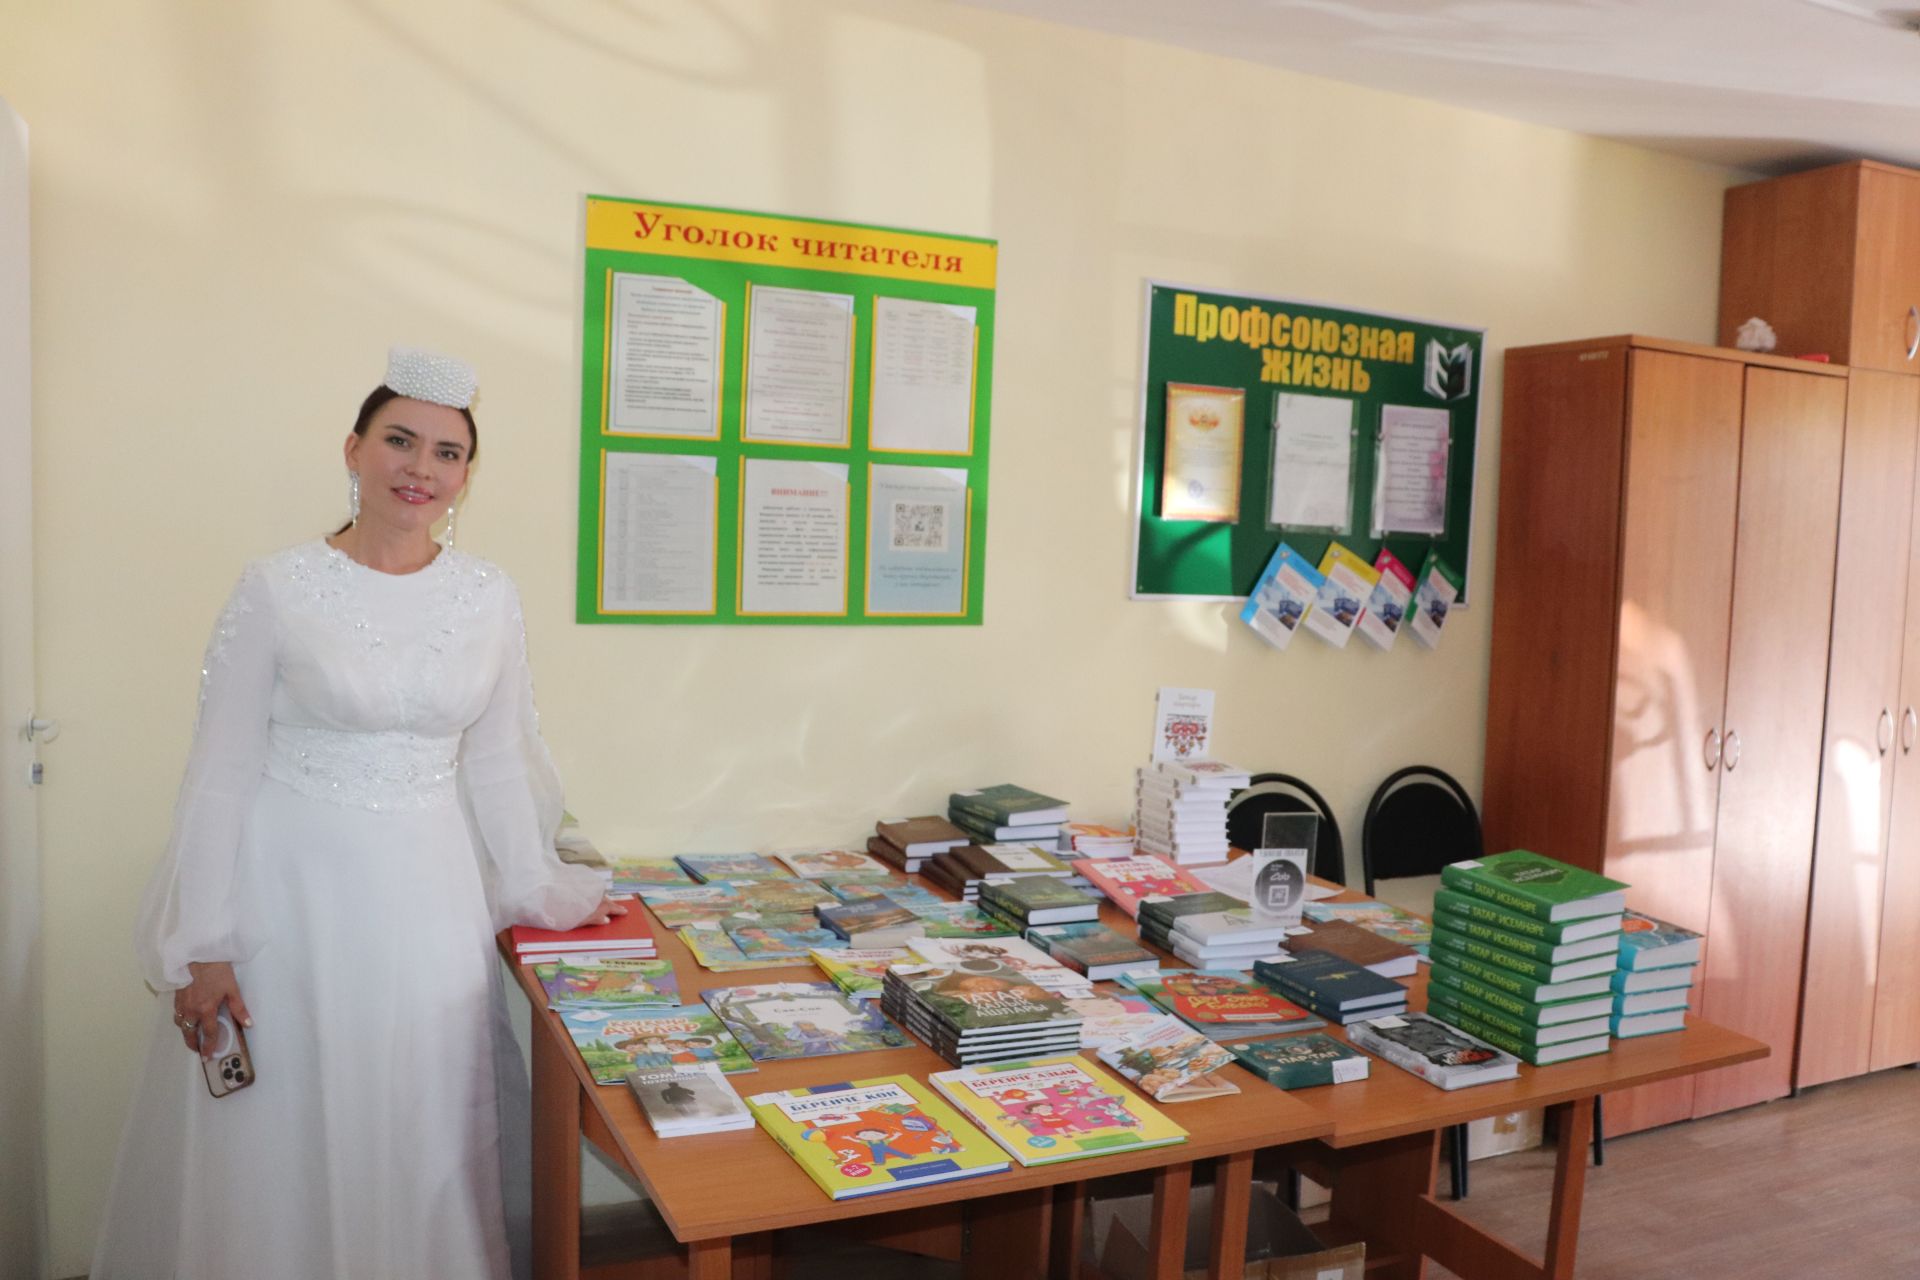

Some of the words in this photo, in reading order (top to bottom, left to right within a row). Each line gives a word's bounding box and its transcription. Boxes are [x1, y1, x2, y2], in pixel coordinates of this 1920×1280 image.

[632, 211, 779, 253] Уголок
[791, 236, 963, 274] читателя
[1173, 293, 1416, 364] Профсоюзная
[957, 988, 1027, 1006] ТАТАР
[789, 1096, 859, 1113] БЕРЕНЧЕ
